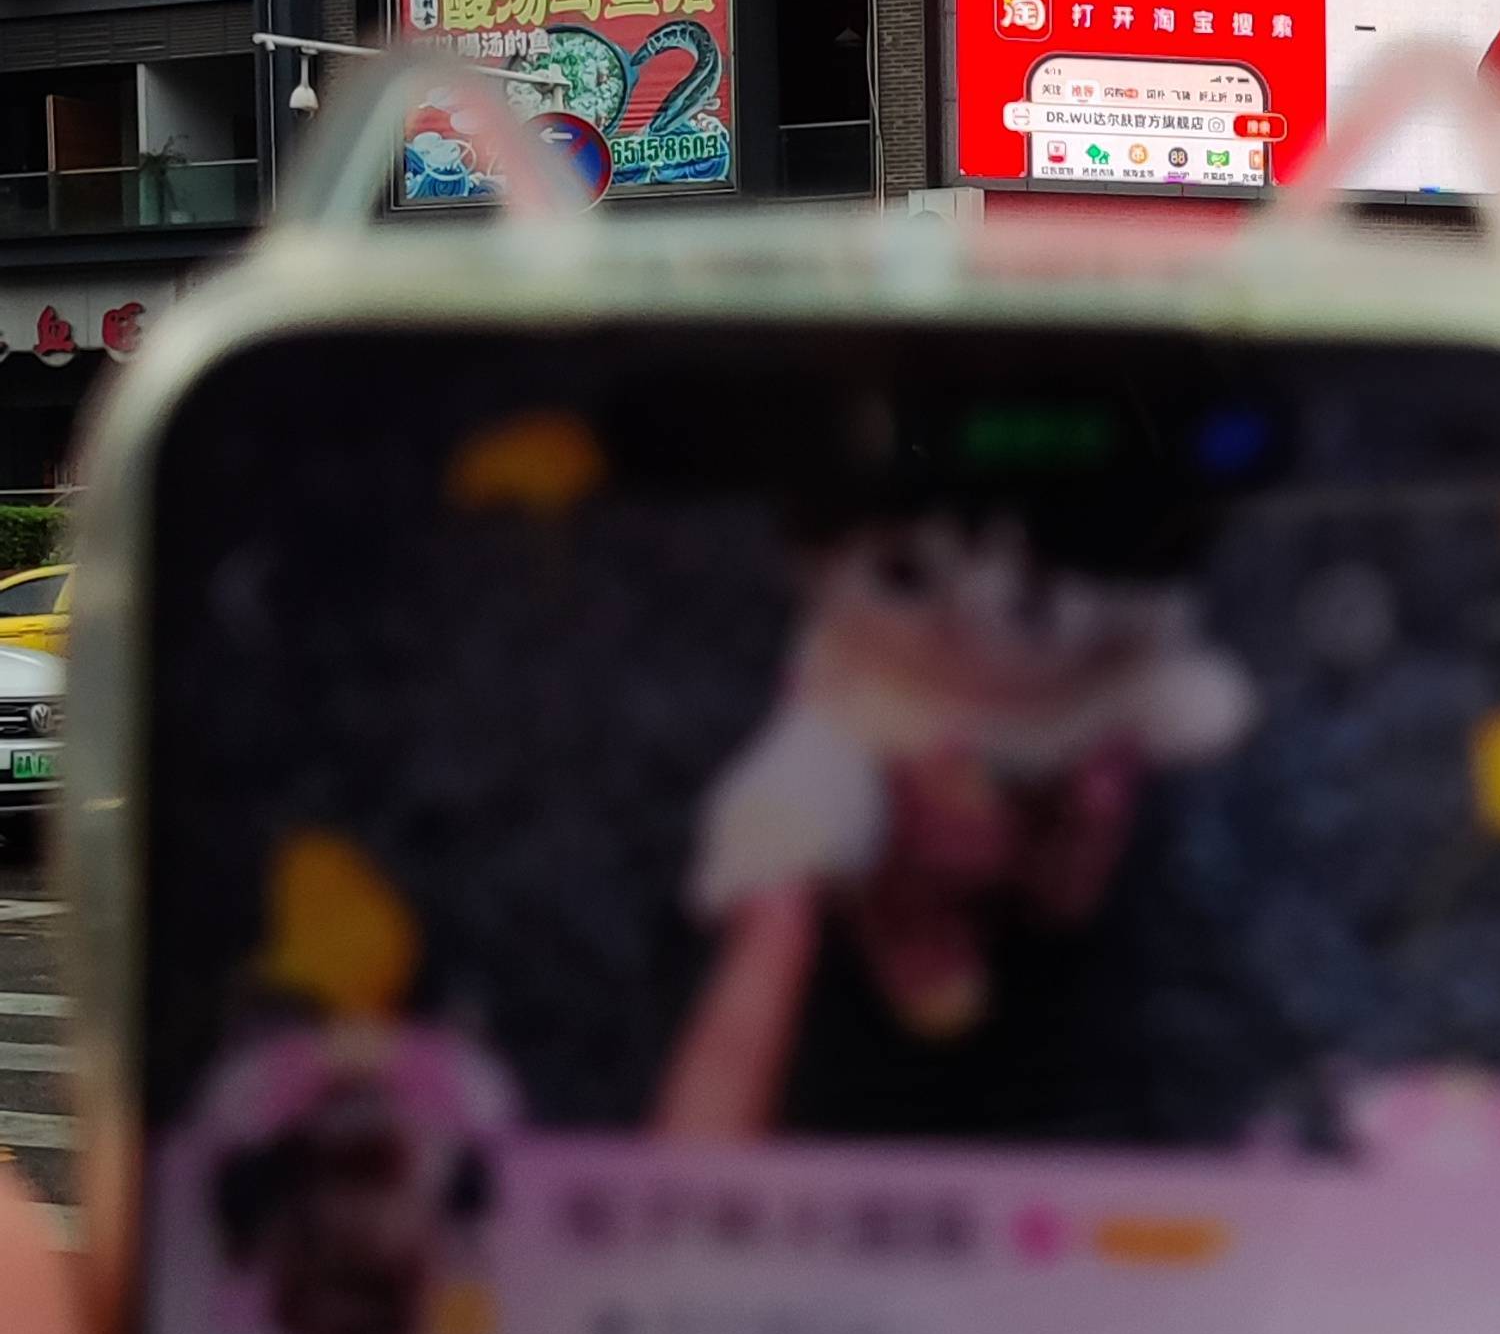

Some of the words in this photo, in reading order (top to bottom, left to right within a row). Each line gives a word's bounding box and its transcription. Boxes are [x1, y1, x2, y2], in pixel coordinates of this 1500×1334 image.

[1071, 3, 1294, 38] 打开淘宝搜索
[1046, 111, 1203, 131] DR.WU达尔肤官方旗舰店
[0, 301, 146, 356] 血旺
